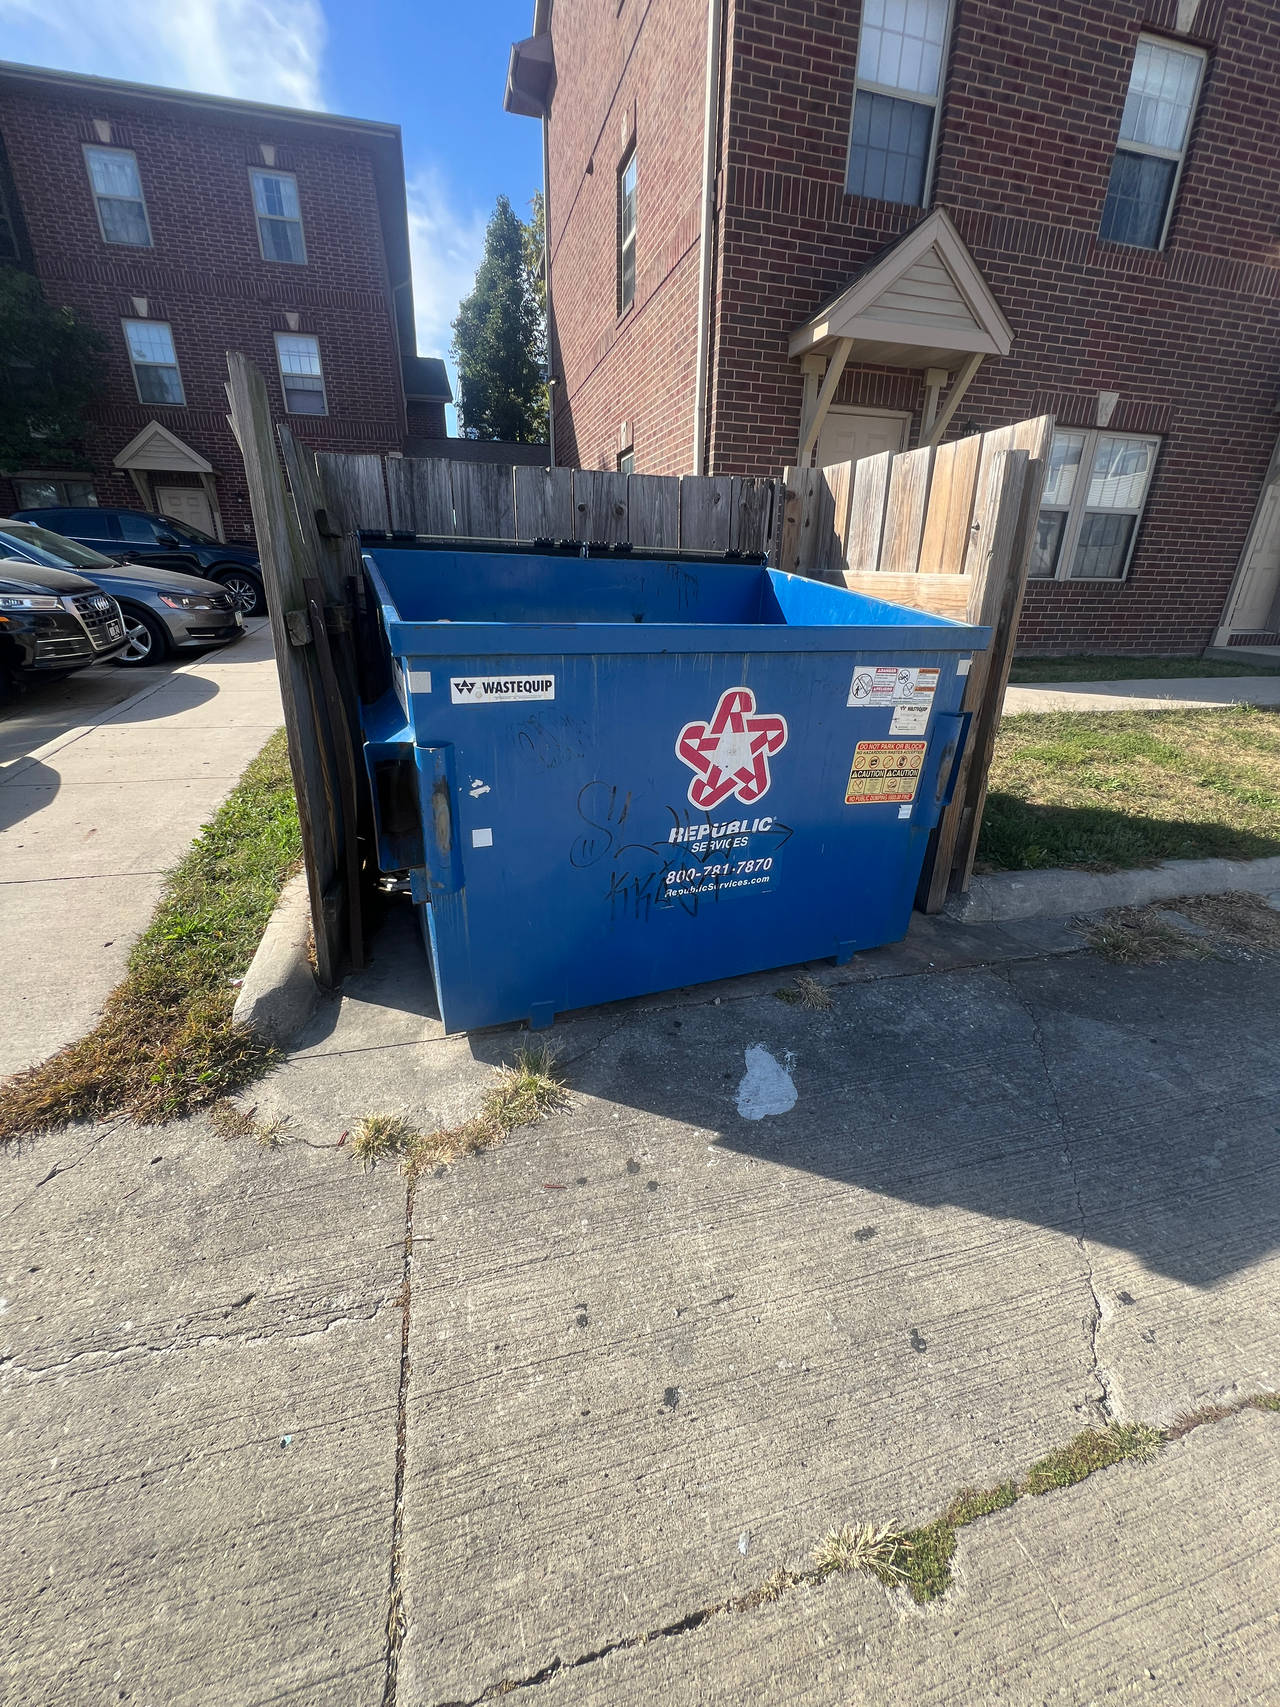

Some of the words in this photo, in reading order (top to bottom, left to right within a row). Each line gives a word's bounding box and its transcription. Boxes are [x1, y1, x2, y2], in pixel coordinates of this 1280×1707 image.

[482, 680, 553, 694] WASTEQUIP
[668, 816, 773, 843] REPUBLIC
[691, 836, 749, 853] SERVICES
